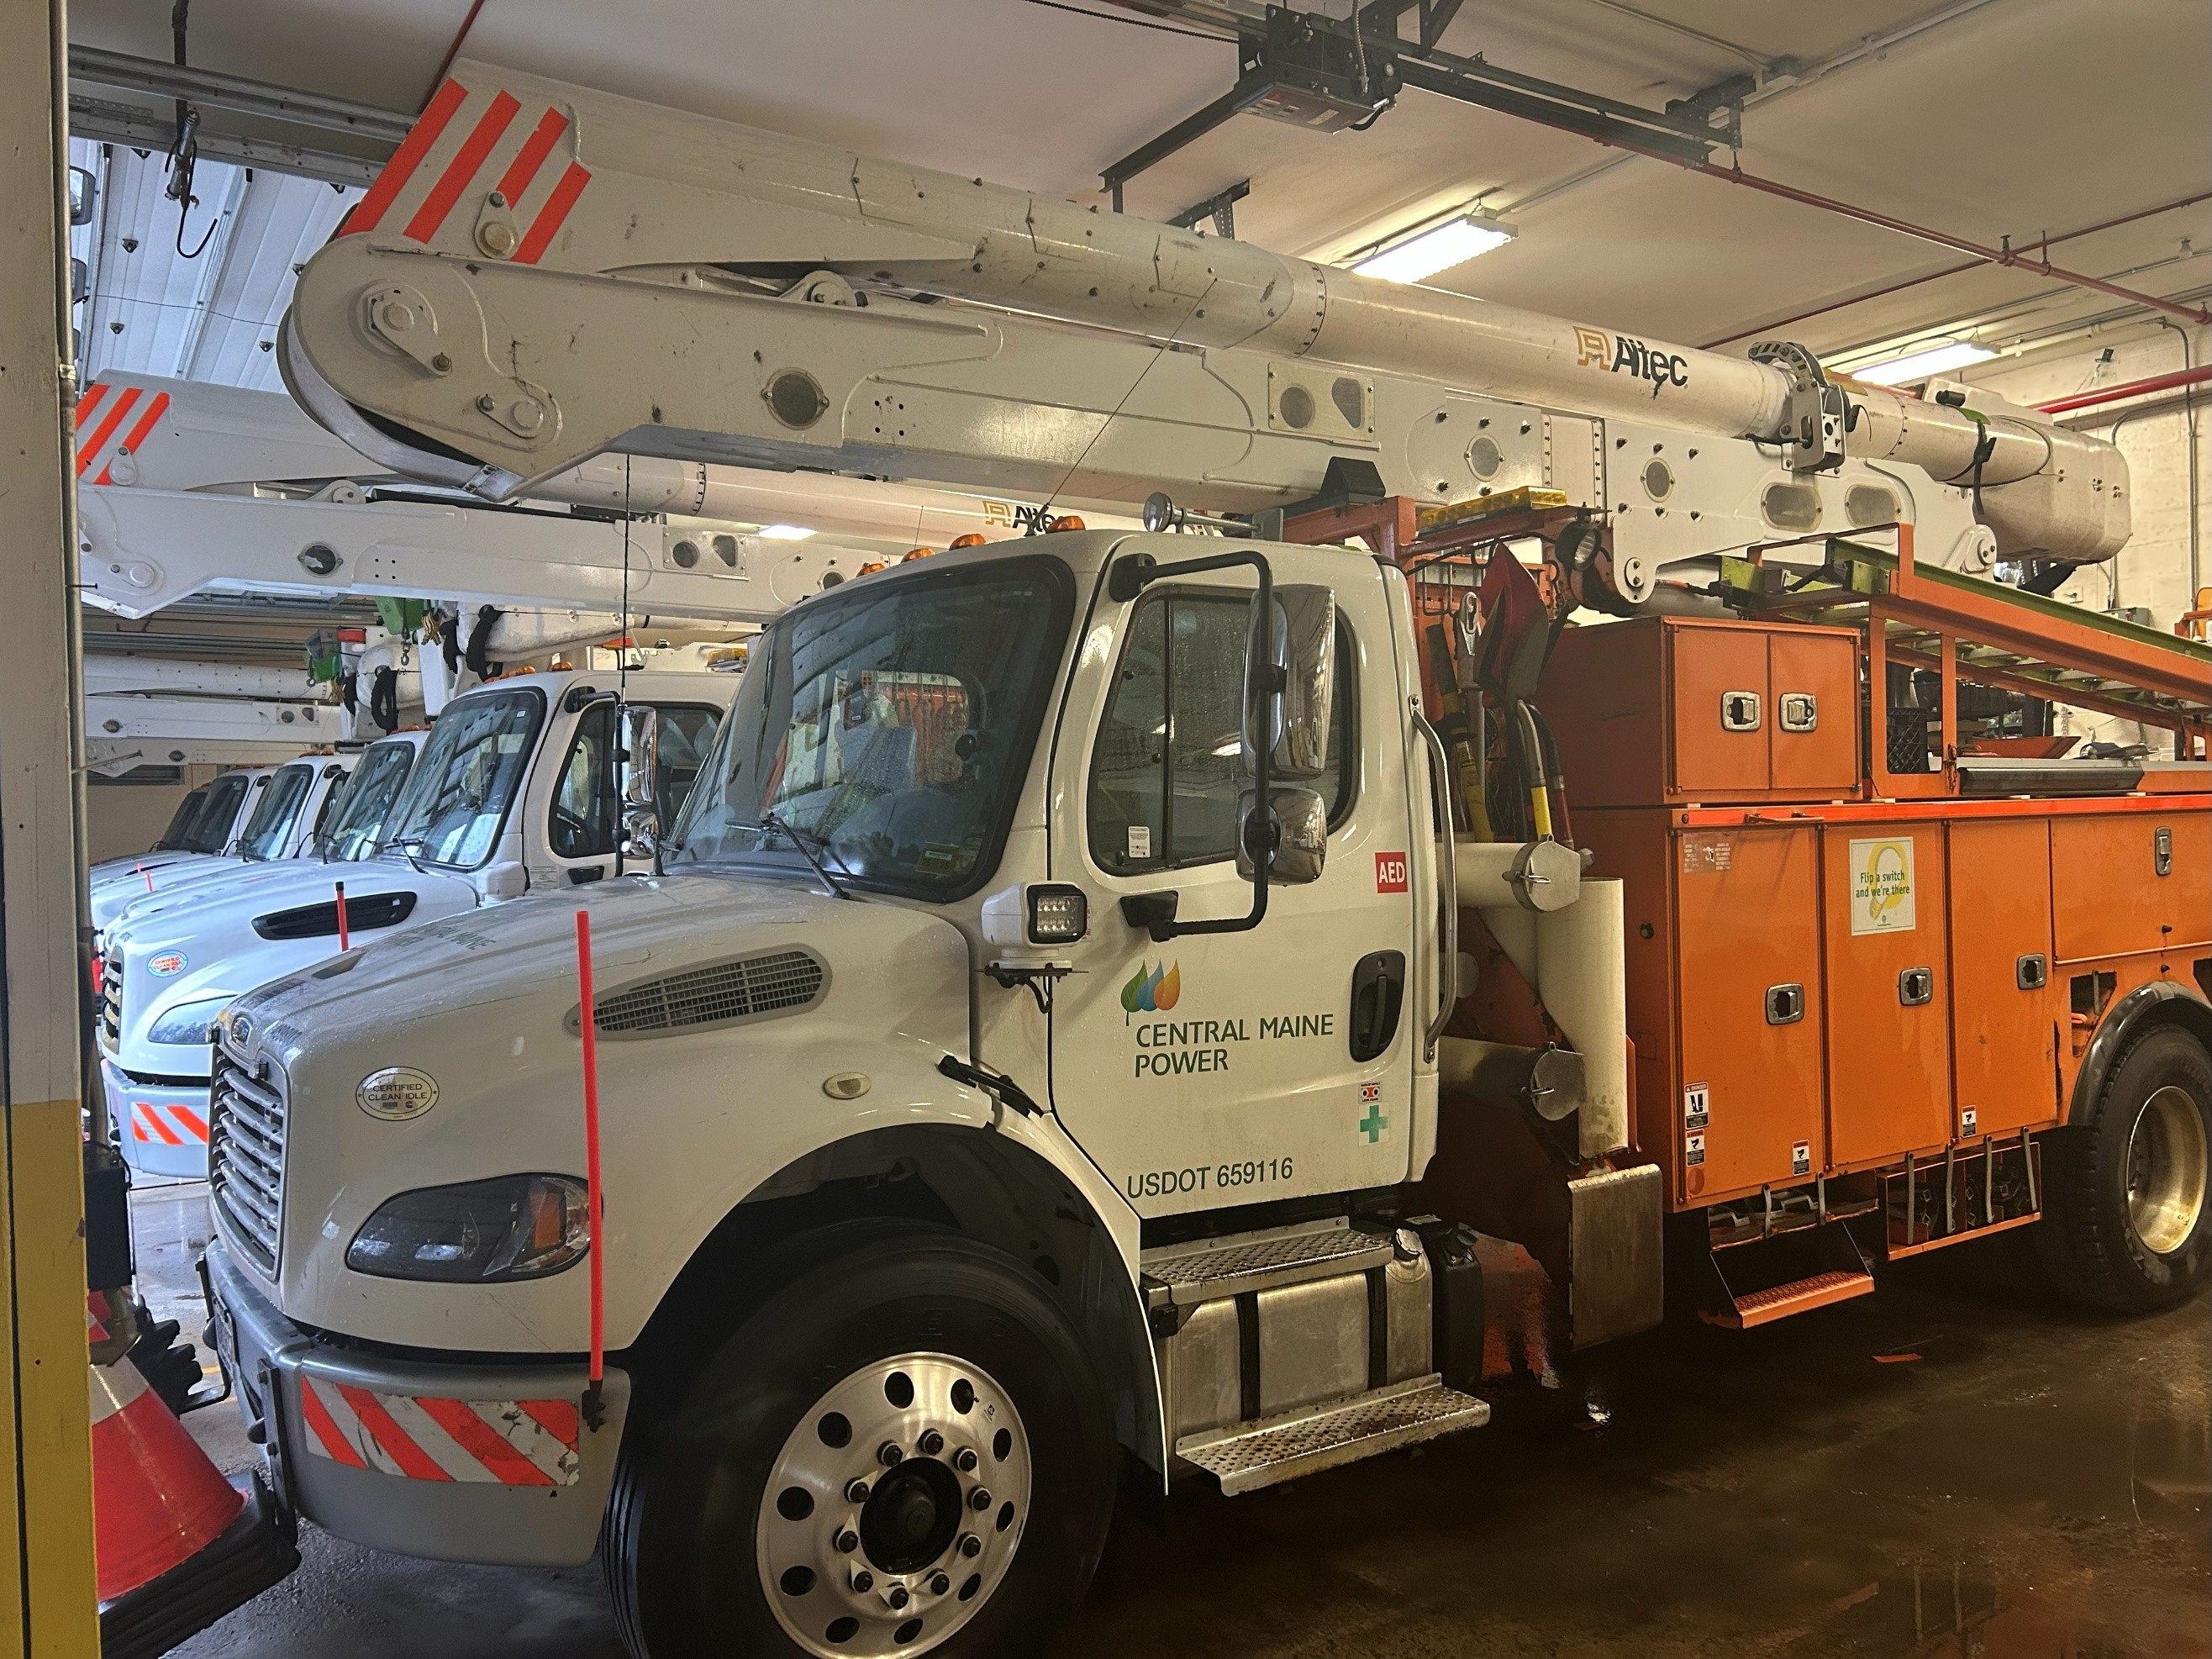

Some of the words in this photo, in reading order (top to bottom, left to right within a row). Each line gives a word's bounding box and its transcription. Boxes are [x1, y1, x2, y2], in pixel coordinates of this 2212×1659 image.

[1611, 336, 1688, 387] Altec
[1013, 506, 1057, 534] Alte
[1378, 861, 1405, 883] AED
[1860, 872, 1874, 885] Flip
[1876, 874, 1881, 882] a
[1882, 870, 1905, 882] switch
[1856, 887, 1869, 898] and
[1871, 885, 1890, 897] we're
[1891, 884, 1910, 896] there
[1135, 1019, 1251, 1048] CENTRAL
[1259, 1014, 1334, 1040] MAINE
[1135, 1048, 1229, 1078] POWER
[373, 1083, 423, 1092] CERTIFIED
[1127, 1166, 1211, 1198] USDOT
[1217, 1156, 1293, 1187] 659116
